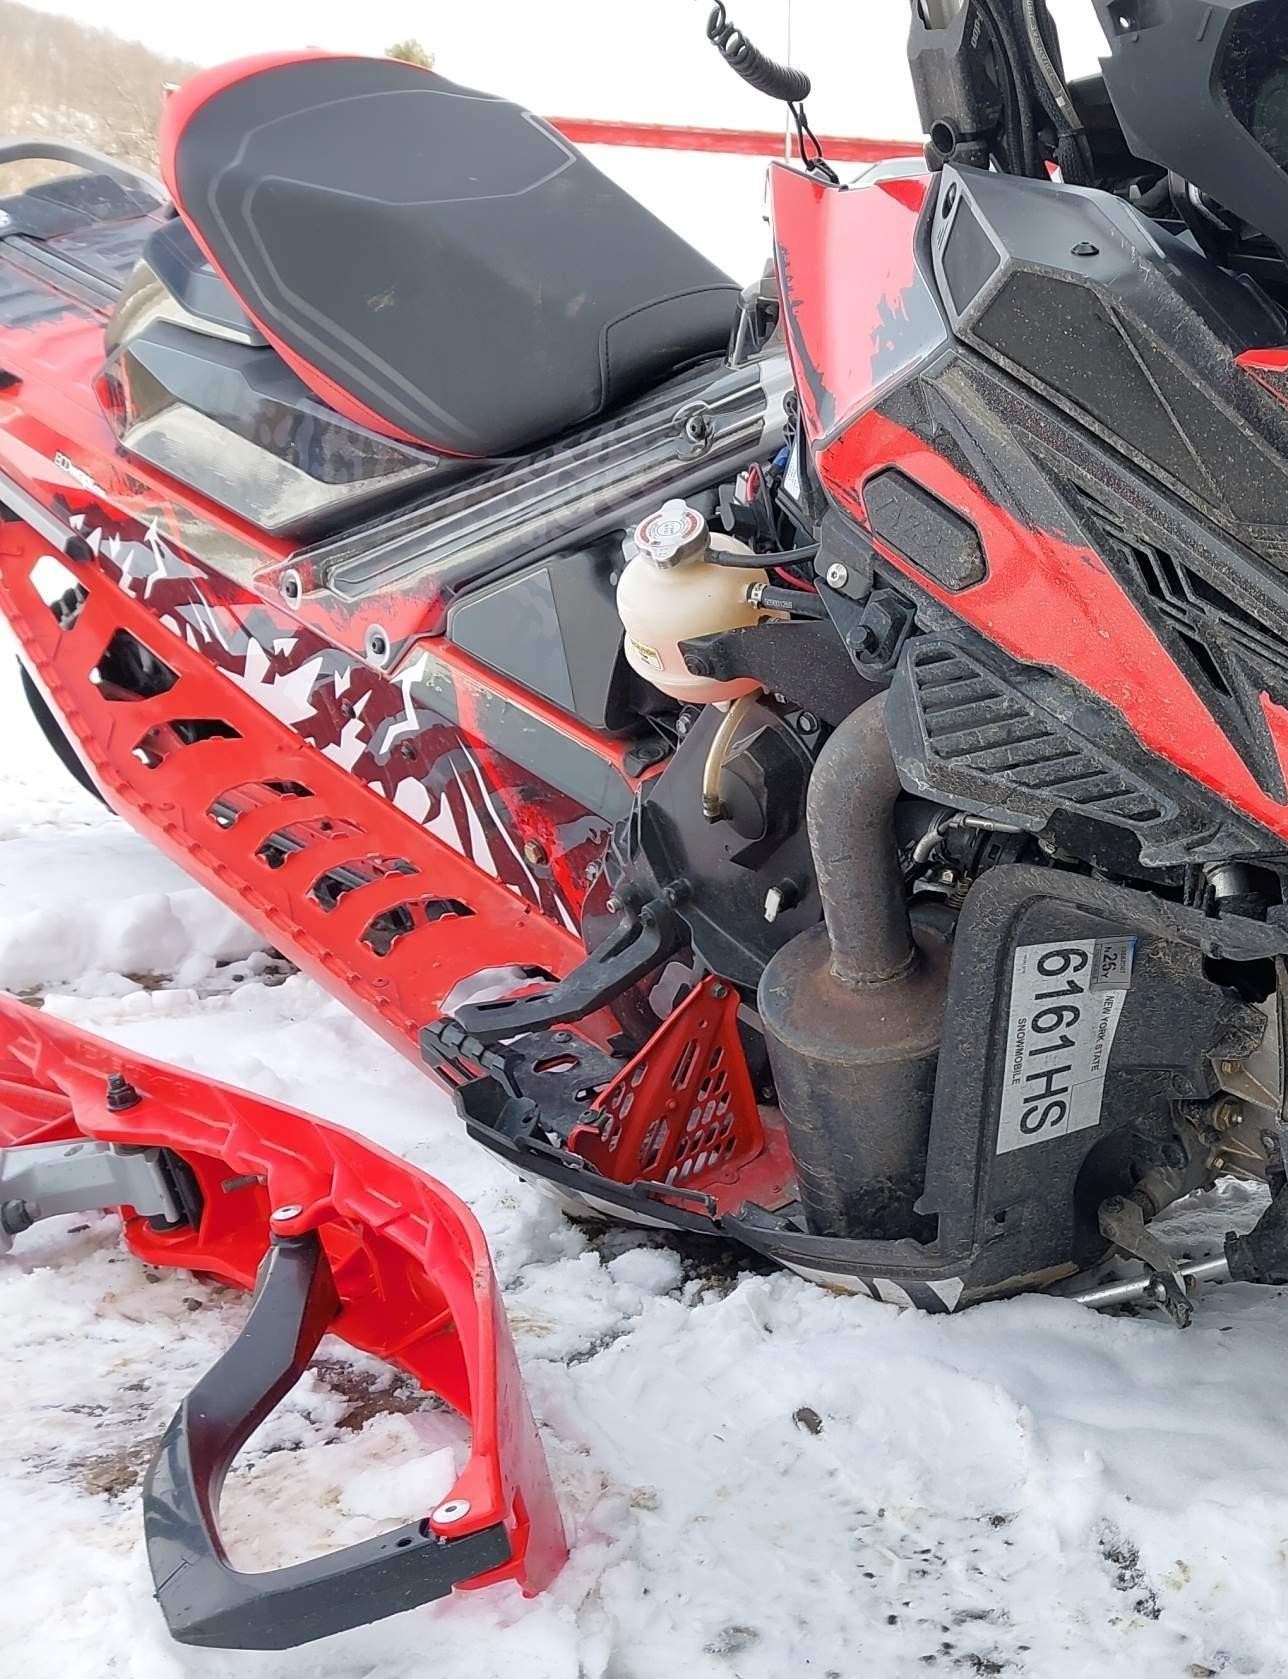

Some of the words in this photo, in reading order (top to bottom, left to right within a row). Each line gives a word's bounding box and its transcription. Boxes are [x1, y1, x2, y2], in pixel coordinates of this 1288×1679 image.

[1102, 995, 1115, 1014] NEW
[1098, 1014, 1110, 1042] YORK
[1011, 1017, 1027, 1086] SNOWMOBILE
[1091, 1041, 1103, 1073] STATE
